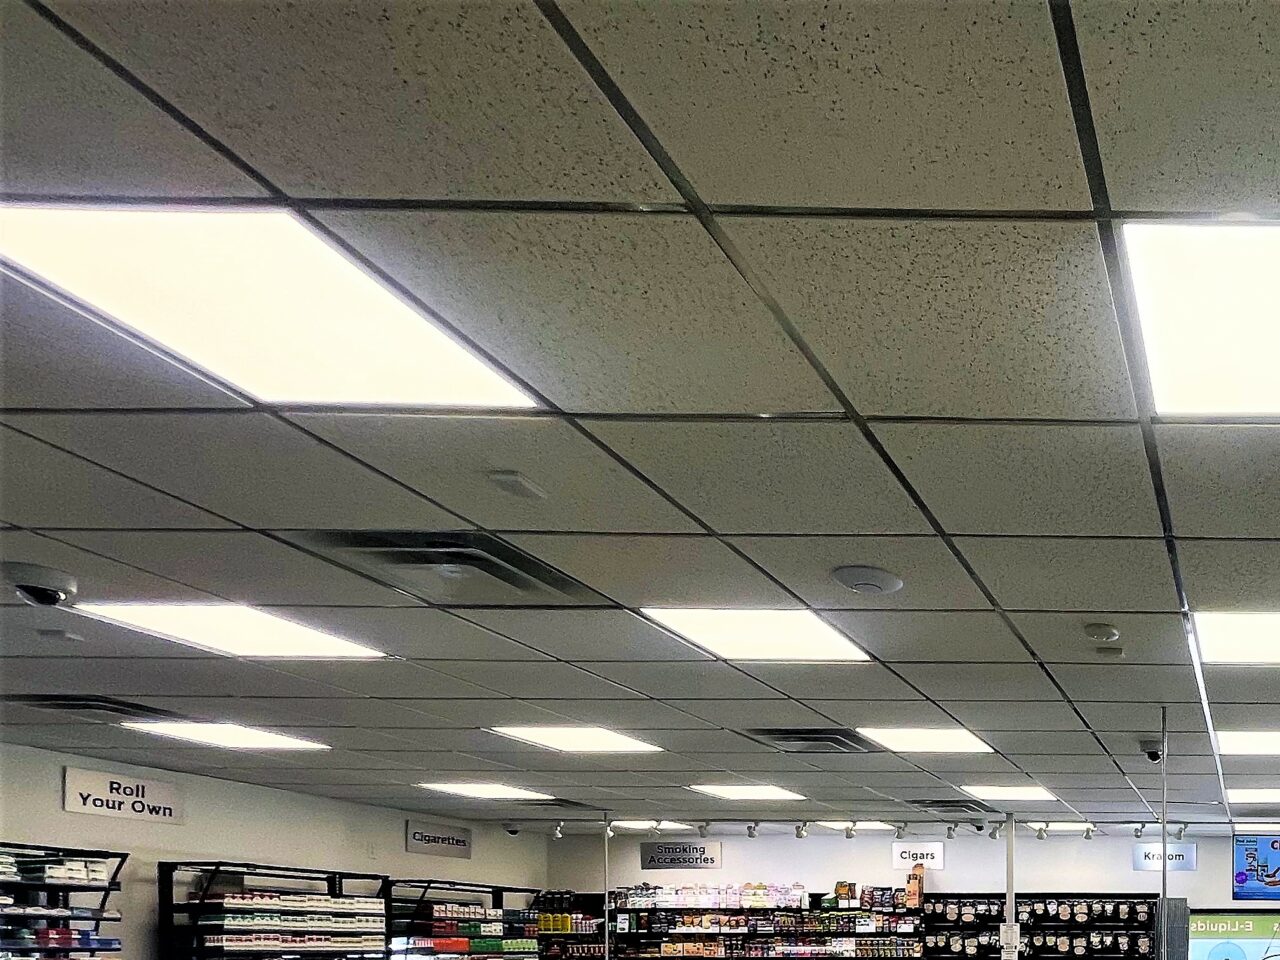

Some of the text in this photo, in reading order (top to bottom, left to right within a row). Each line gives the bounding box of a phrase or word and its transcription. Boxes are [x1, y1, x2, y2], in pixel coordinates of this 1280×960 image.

[109, 781, 145, 798] Roll
[79, 792, 173, 817] Your Own
[413, 831, 467, 846] Cigarettes
[657, 845, 706, 855] Smoking
[900, 850, 935, 861] Cigars
[648, 855, 715, 864] Accessories
[1144, 852, 1185, 861] Kraom
